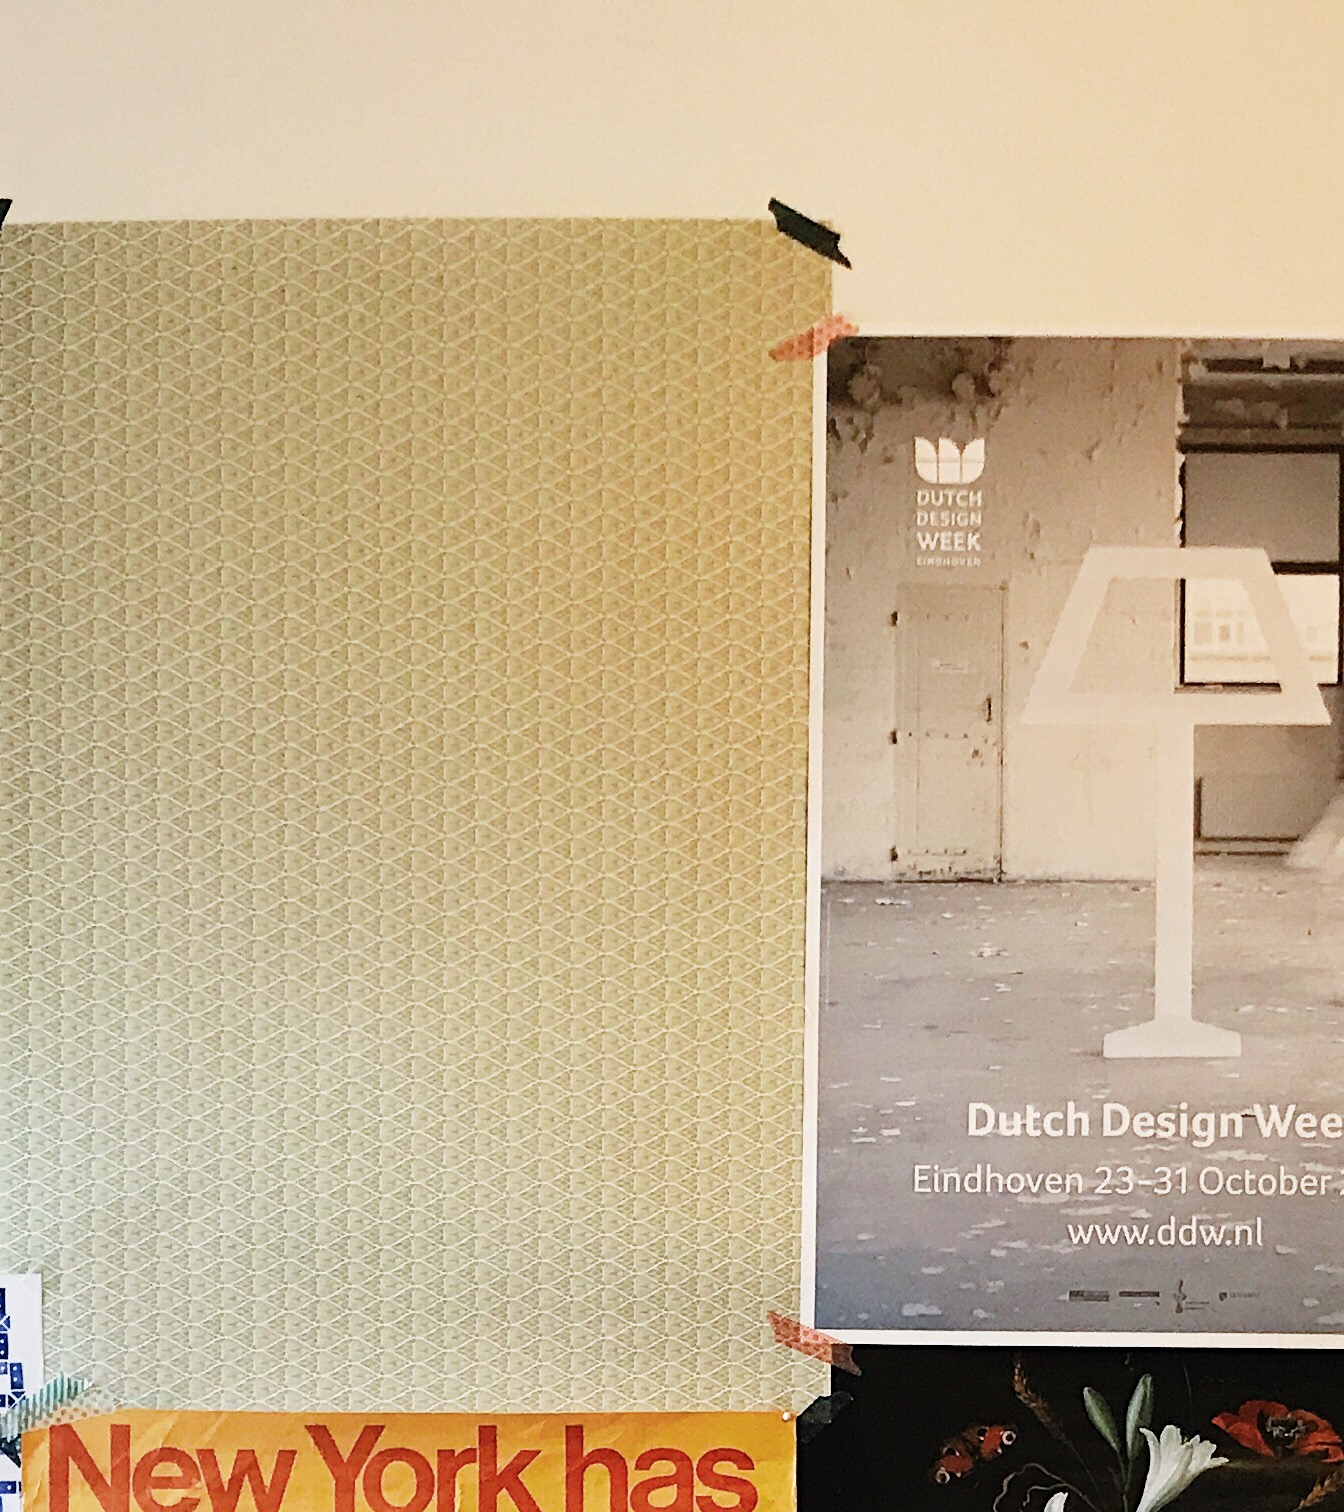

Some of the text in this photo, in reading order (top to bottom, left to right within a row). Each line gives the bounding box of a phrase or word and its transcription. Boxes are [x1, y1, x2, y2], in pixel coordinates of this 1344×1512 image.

[917, 490, 982, 507] DUTCH
[917, 511, 982, 526] DESIGN
[917, 532, 981, 551] WEEK
[968, 1102, 1090, 1139] Dutch
[1103, 1102, 1242, 1146] Design
[912, 1165, 1082, 1196] Eindhoven
[1094, 1168, 1188, 1196] 23-31
[1200, 1165, 1332, 1196] October
[1067, 1218, 1264, 1245] www.ddw.nl
